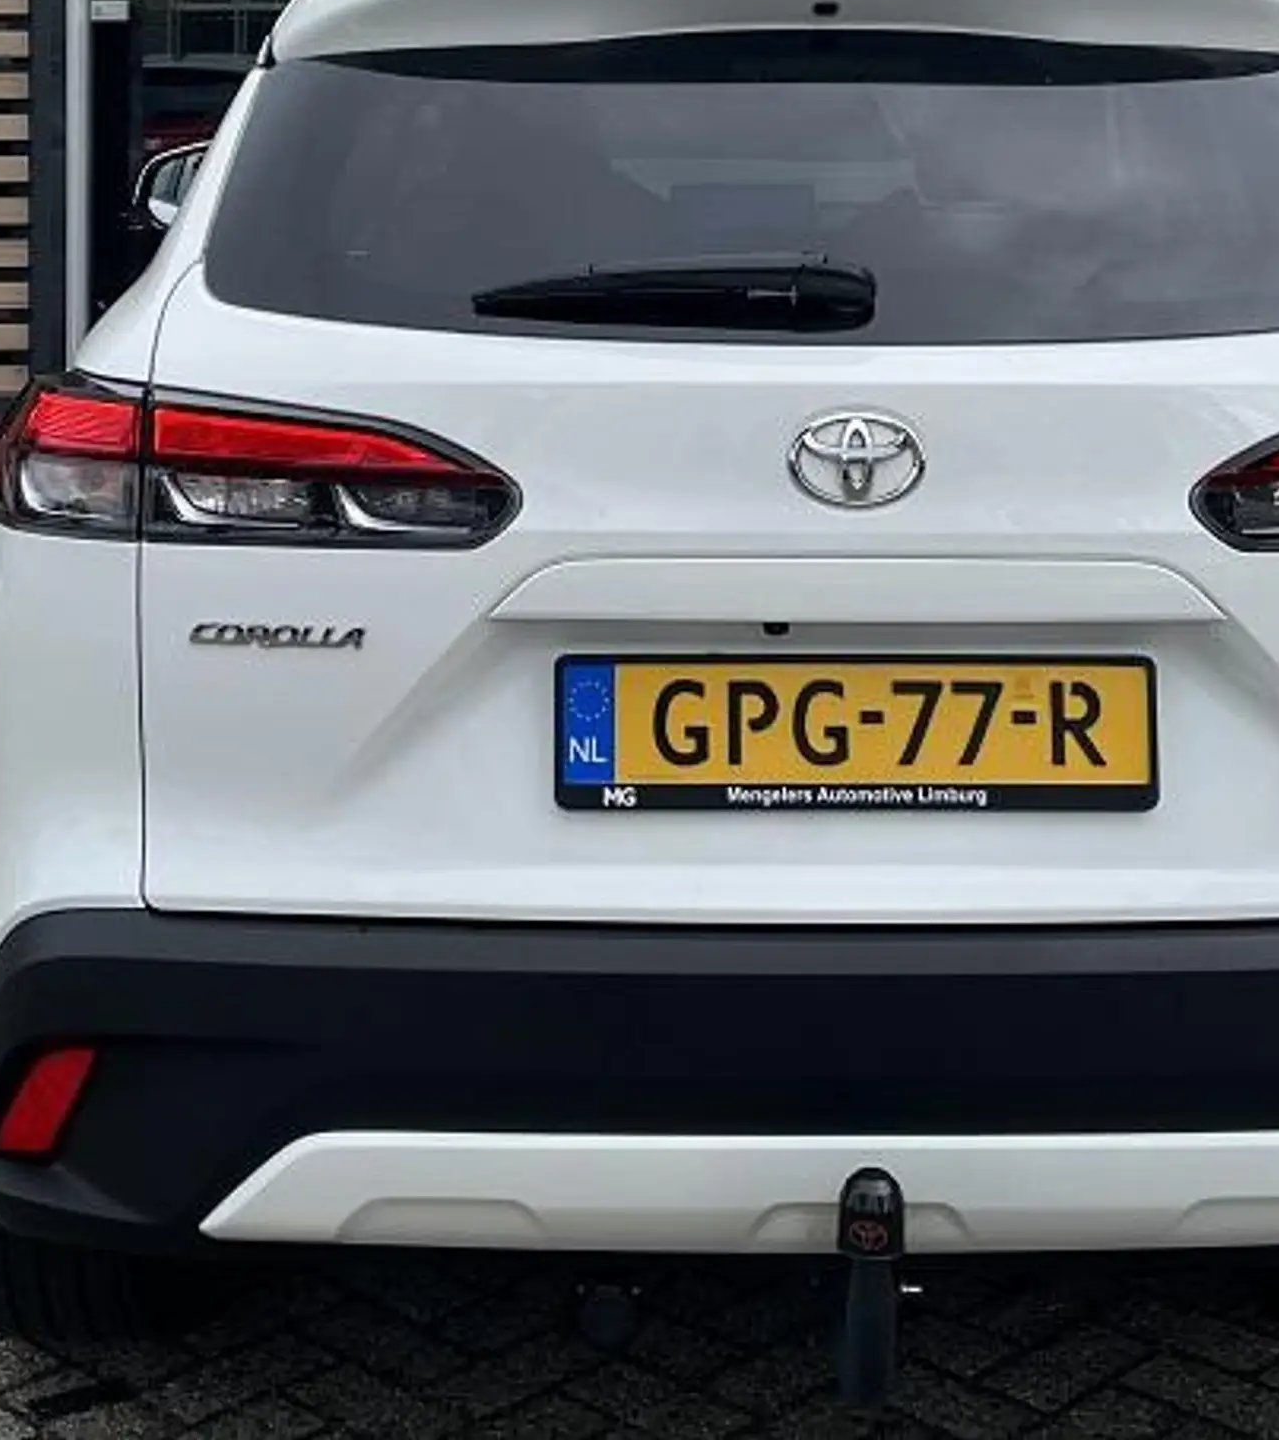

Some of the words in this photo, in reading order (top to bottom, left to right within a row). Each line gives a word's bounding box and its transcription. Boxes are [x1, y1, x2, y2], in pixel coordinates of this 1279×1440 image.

[189, 624, 366, 650] COROLLA
[652, 679, 1107, 766] GPG-77-R
[568, 735, 608, 764] NL
[602, 786, 638, 807] MG
[727, 786, 813, 807] Mengelers
[817, 786, 915, 804] Automotive
[918, 786, 987, 807] Limburg
